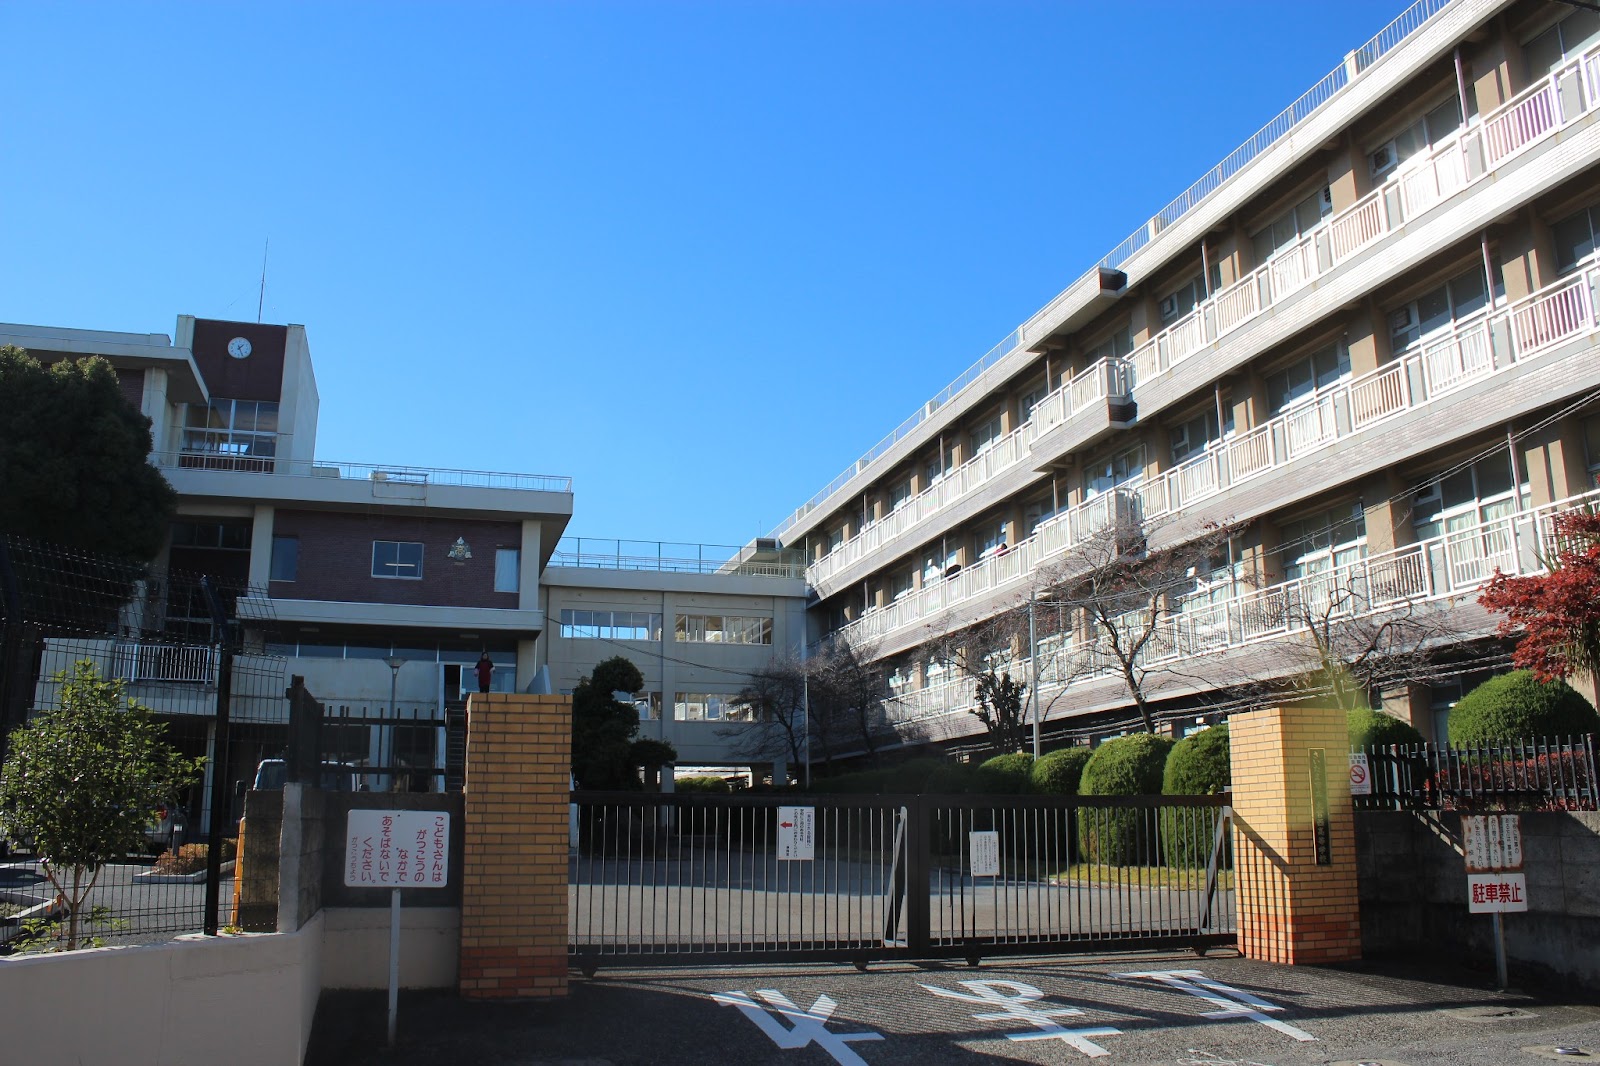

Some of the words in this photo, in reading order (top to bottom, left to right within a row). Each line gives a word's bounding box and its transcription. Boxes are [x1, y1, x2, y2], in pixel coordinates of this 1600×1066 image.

[361, 837, 376, 884] ください。
[379, 815, 392, 882] あそばないで
[397, 849, 408, 882] なかで
[431, 816, 444, 882] こどもさんは
[1472, 882, 1523, 904] 駐車禁止
